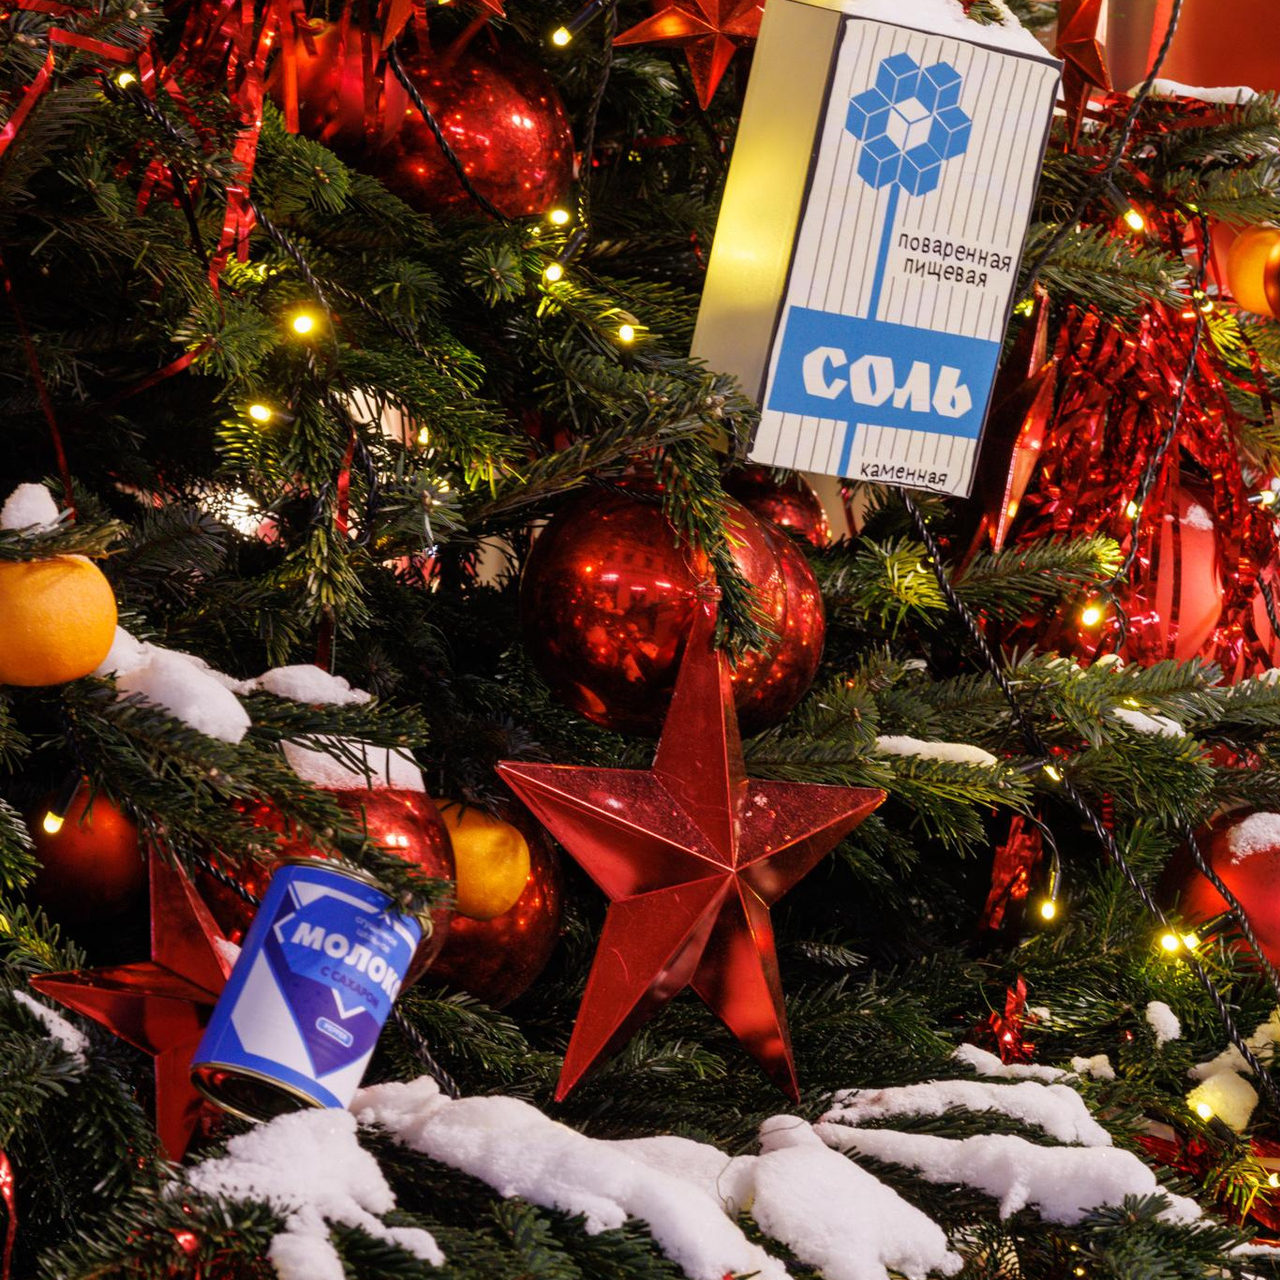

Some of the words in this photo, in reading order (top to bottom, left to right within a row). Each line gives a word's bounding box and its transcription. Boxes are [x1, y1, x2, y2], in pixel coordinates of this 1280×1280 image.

[898, 231, 1012, 273] поваренная
[903, 255, 988, 288] пищевая
[802, 345, 973, 419] СОЛЬ
[860, 461, 948, 487] каменная
